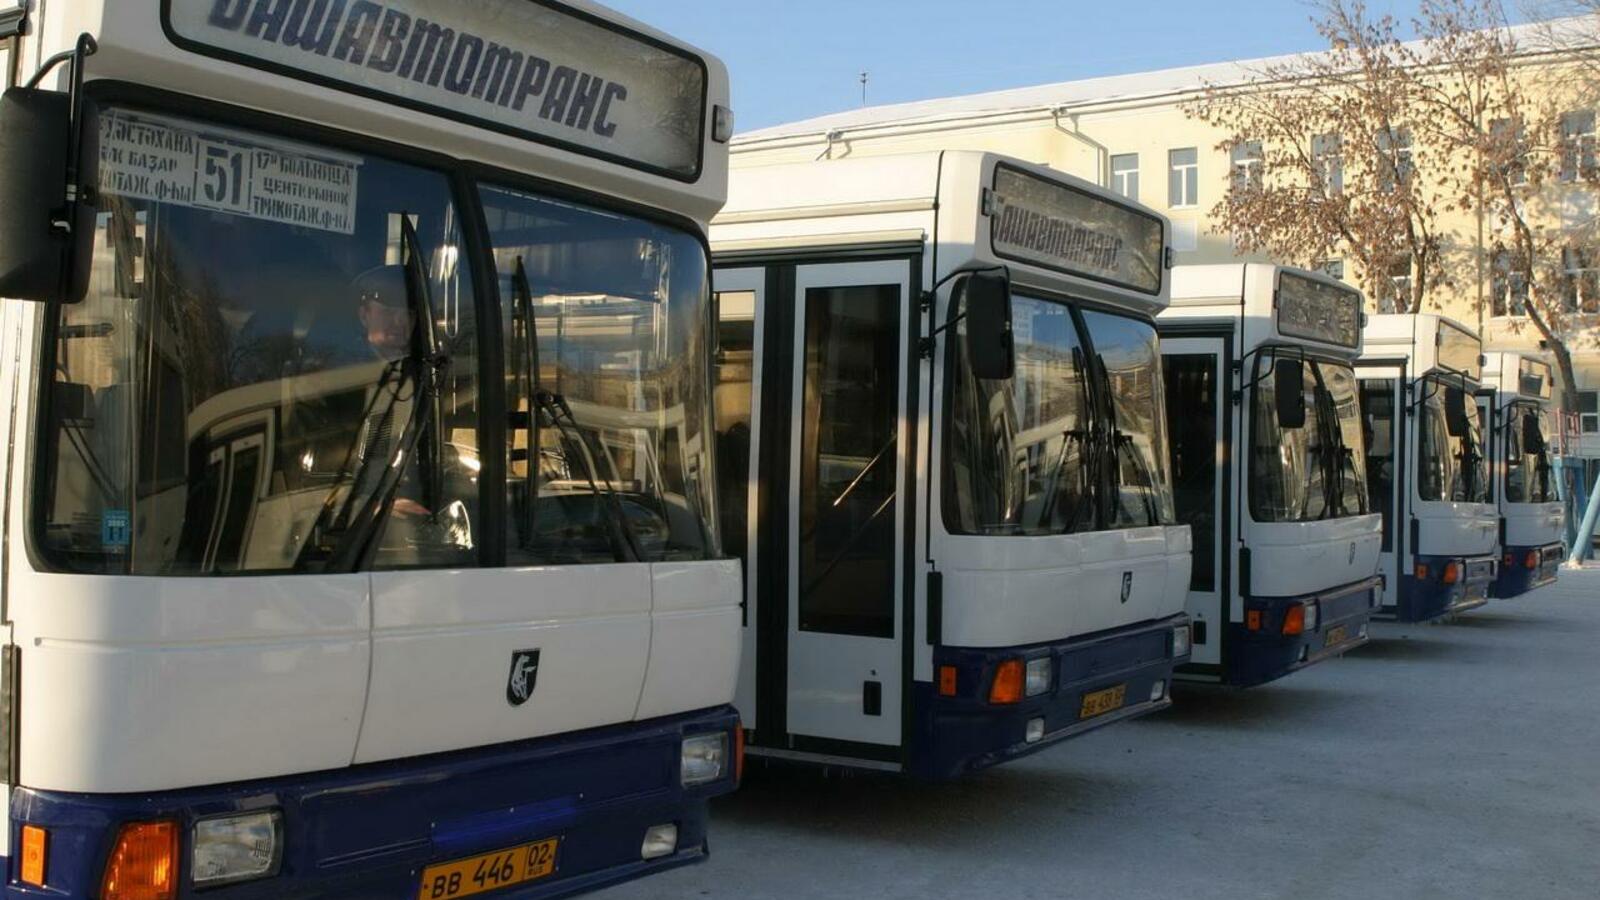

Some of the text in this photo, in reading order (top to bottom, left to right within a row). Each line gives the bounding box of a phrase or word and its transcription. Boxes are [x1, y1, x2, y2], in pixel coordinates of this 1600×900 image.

[204, 146, 243, 206] 51
[473, 851, 515, 888] 446
[528, 842, 550, 867] 02
